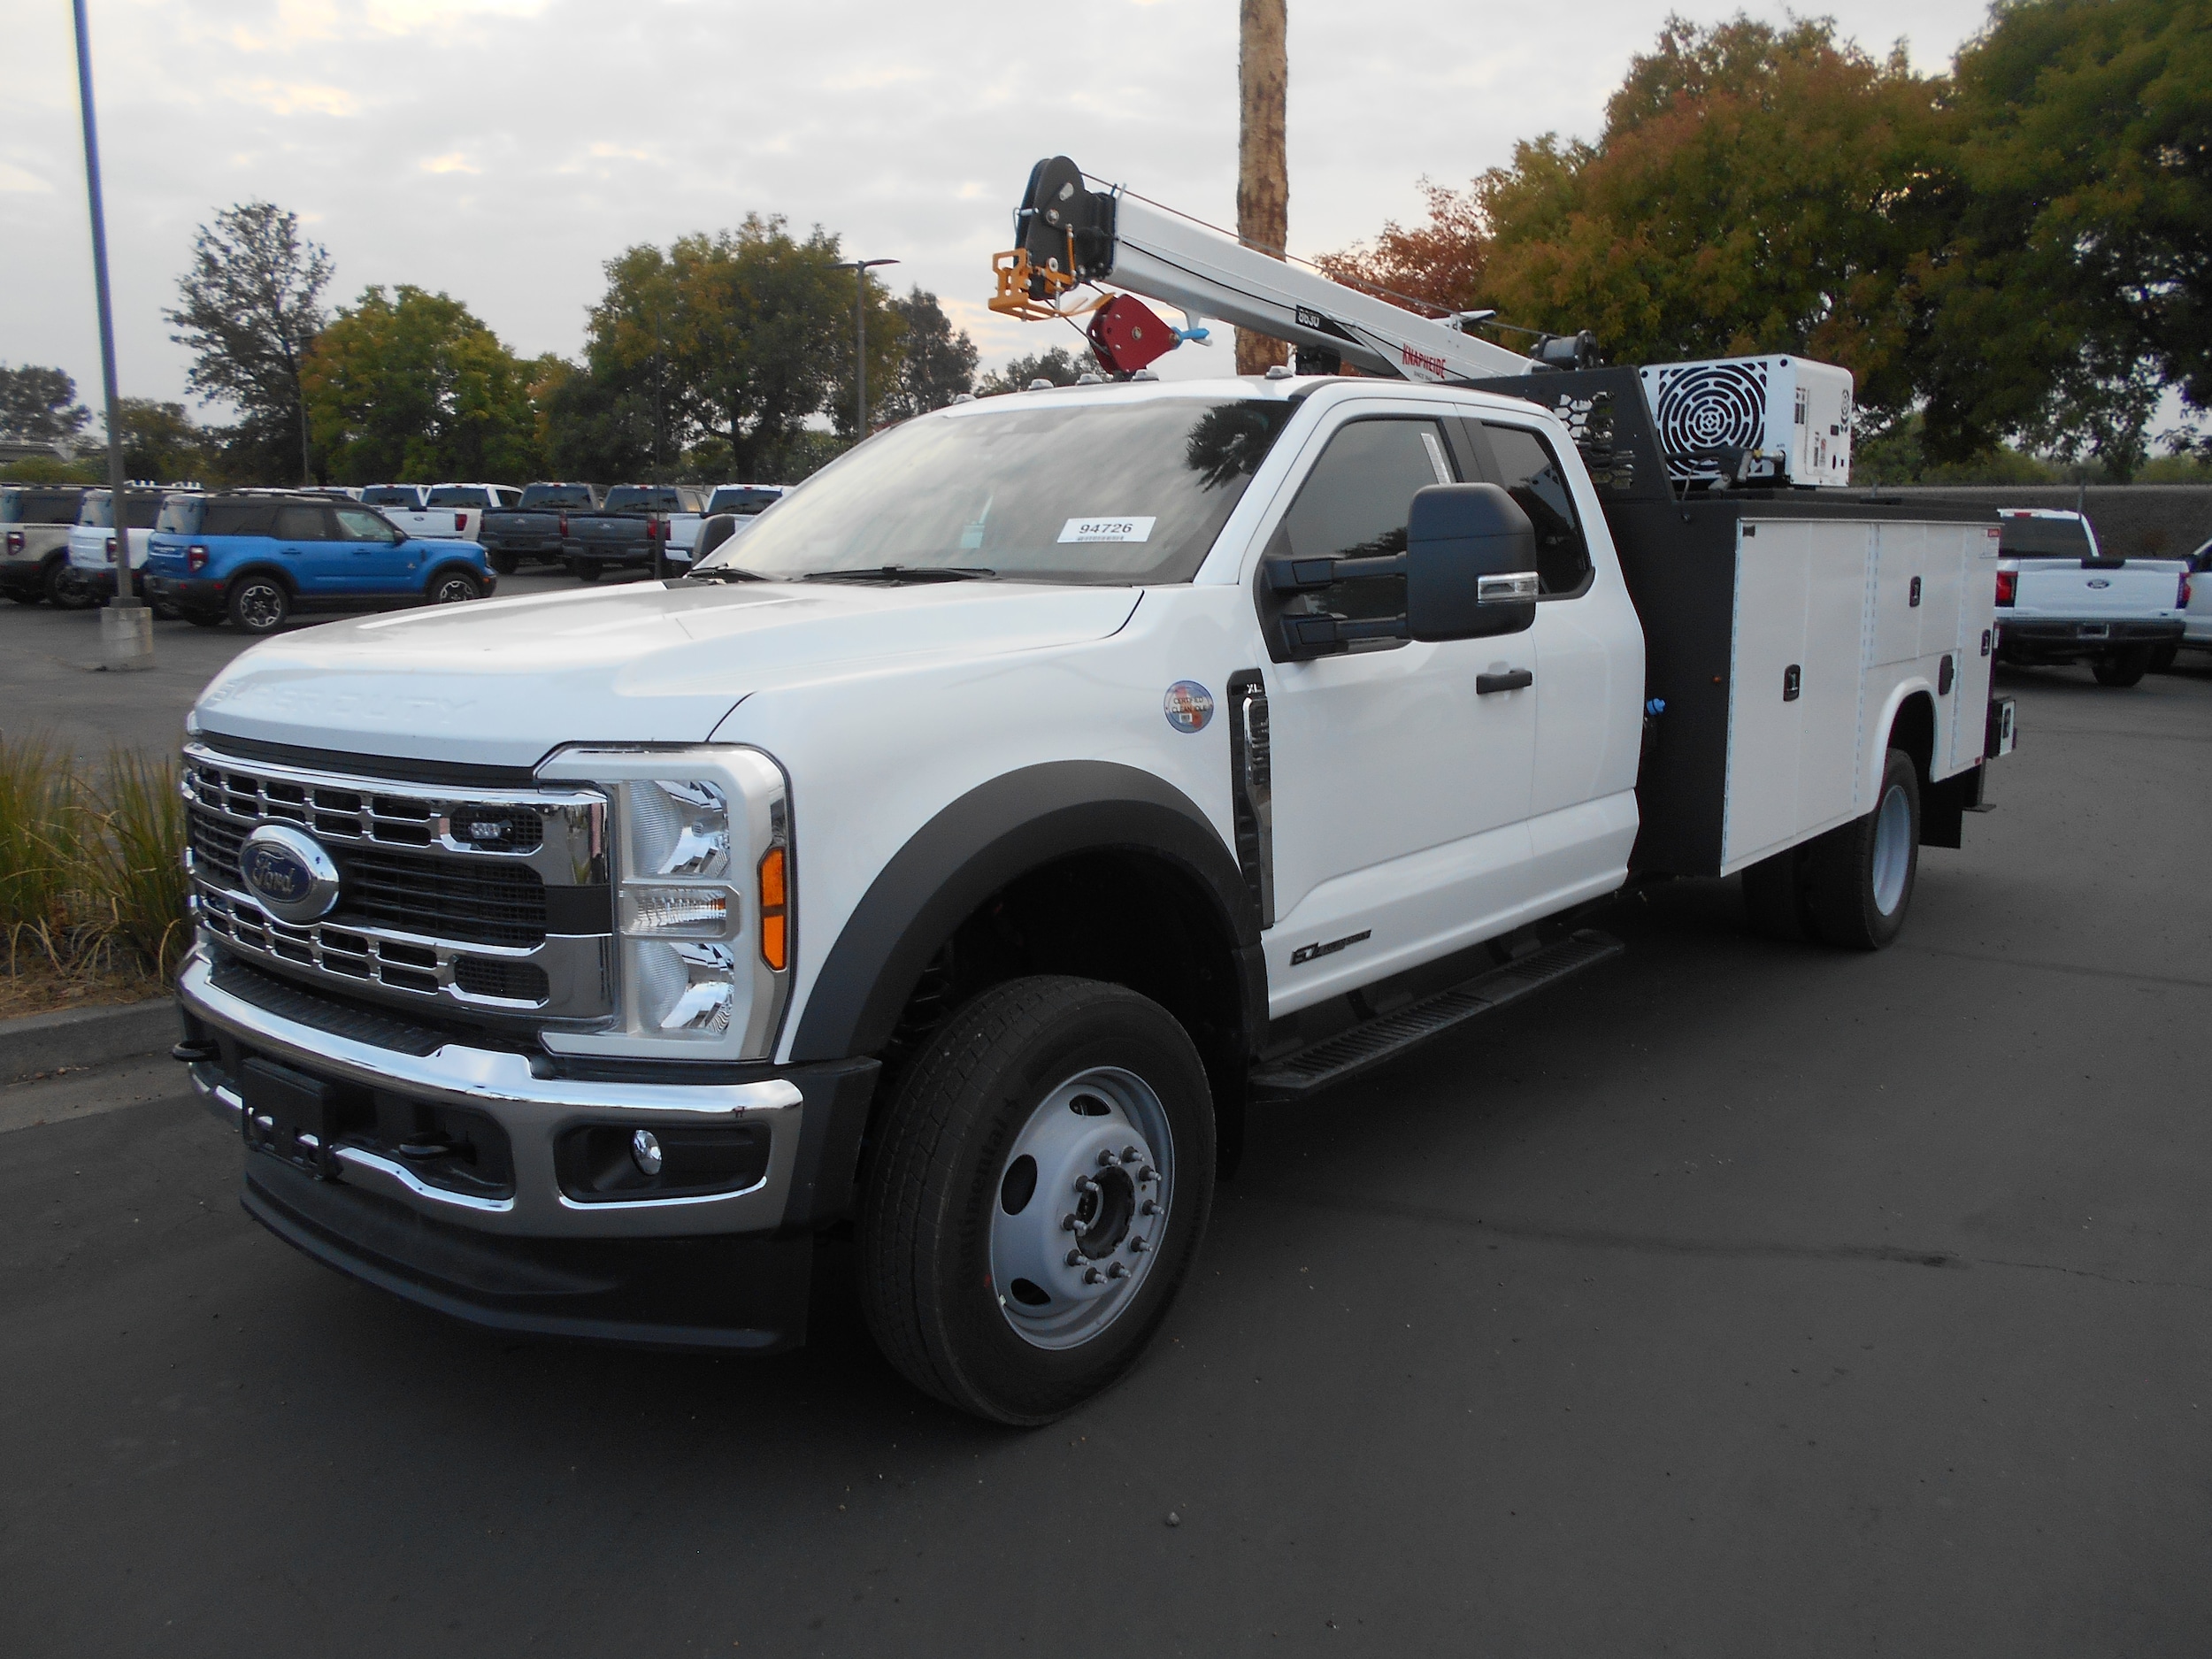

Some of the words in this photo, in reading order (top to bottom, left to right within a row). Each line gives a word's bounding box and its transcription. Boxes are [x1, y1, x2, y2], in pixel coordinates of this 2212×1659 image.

[1402, 342, 1446, 380] KNAPHEIDE
[1079, 523, 1133, 534] 94726
[1247, 683, 1262, 695] XL
[252, 849, 296, 895] Ford
